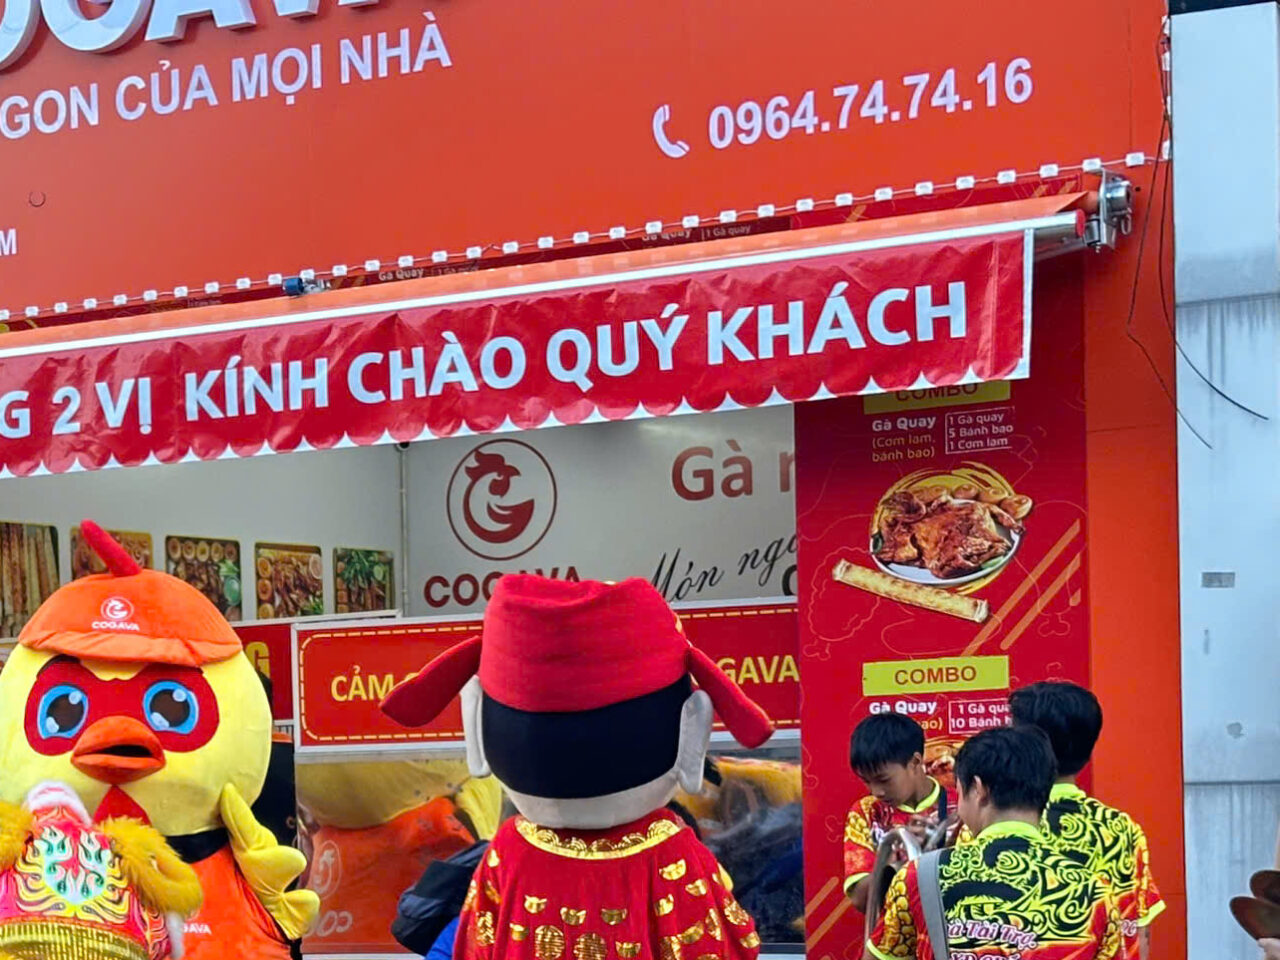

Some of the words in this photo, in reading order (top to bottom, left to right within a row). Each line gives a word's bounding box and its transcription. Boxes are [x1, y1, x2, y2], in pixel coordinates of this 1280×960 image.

[114, 60, 219, 121] CỦA
[231, 44, 322, 106] MỌI
[339, 11, 452, 86] NHÀ
[707, 56, 1034, 149] 0964.74.74.16
[51, 386, 84, 436] 2
[93, 375, 153, 436] VỊ
[185, 352, 330, 423] KÍNH
[346, 332, 525, 405] CHÀO
[545, 302, 685, 394] QUÝ
[708, 279, 969, 365] KHÁCH
[872, 418, 893, 432] Gà
[896, 415, 937, 431] Quay
[949, 416, 955, 426] 1
[957, 414, 973, 424] Gà
[976, 412, 1005, 424] quay
[948, 429, 956, 438] 5
[959, 425, 988, 437] Bánh
[949, 441, 955, 450] 1
[957, 439, 984, 450] Cơm
[987, 437, 1008, 447] lam
[872, 449, 904, 462] bánh
[907, 446, 935, 459] bao)
[671, 438, 754, 501] Gà
[331, 665, 395, 702] CẢM
[894, 665, 977, 686] COMBO
[869, 701, 891, 715] Gà
[895, 700, 937, 714] Quay
[968, 703, 986, 714] Gà
[951, 718, 965, 728] 10
[968, 716, 1001, 728] Bánh
[966, 919, 998, 940] Tài
